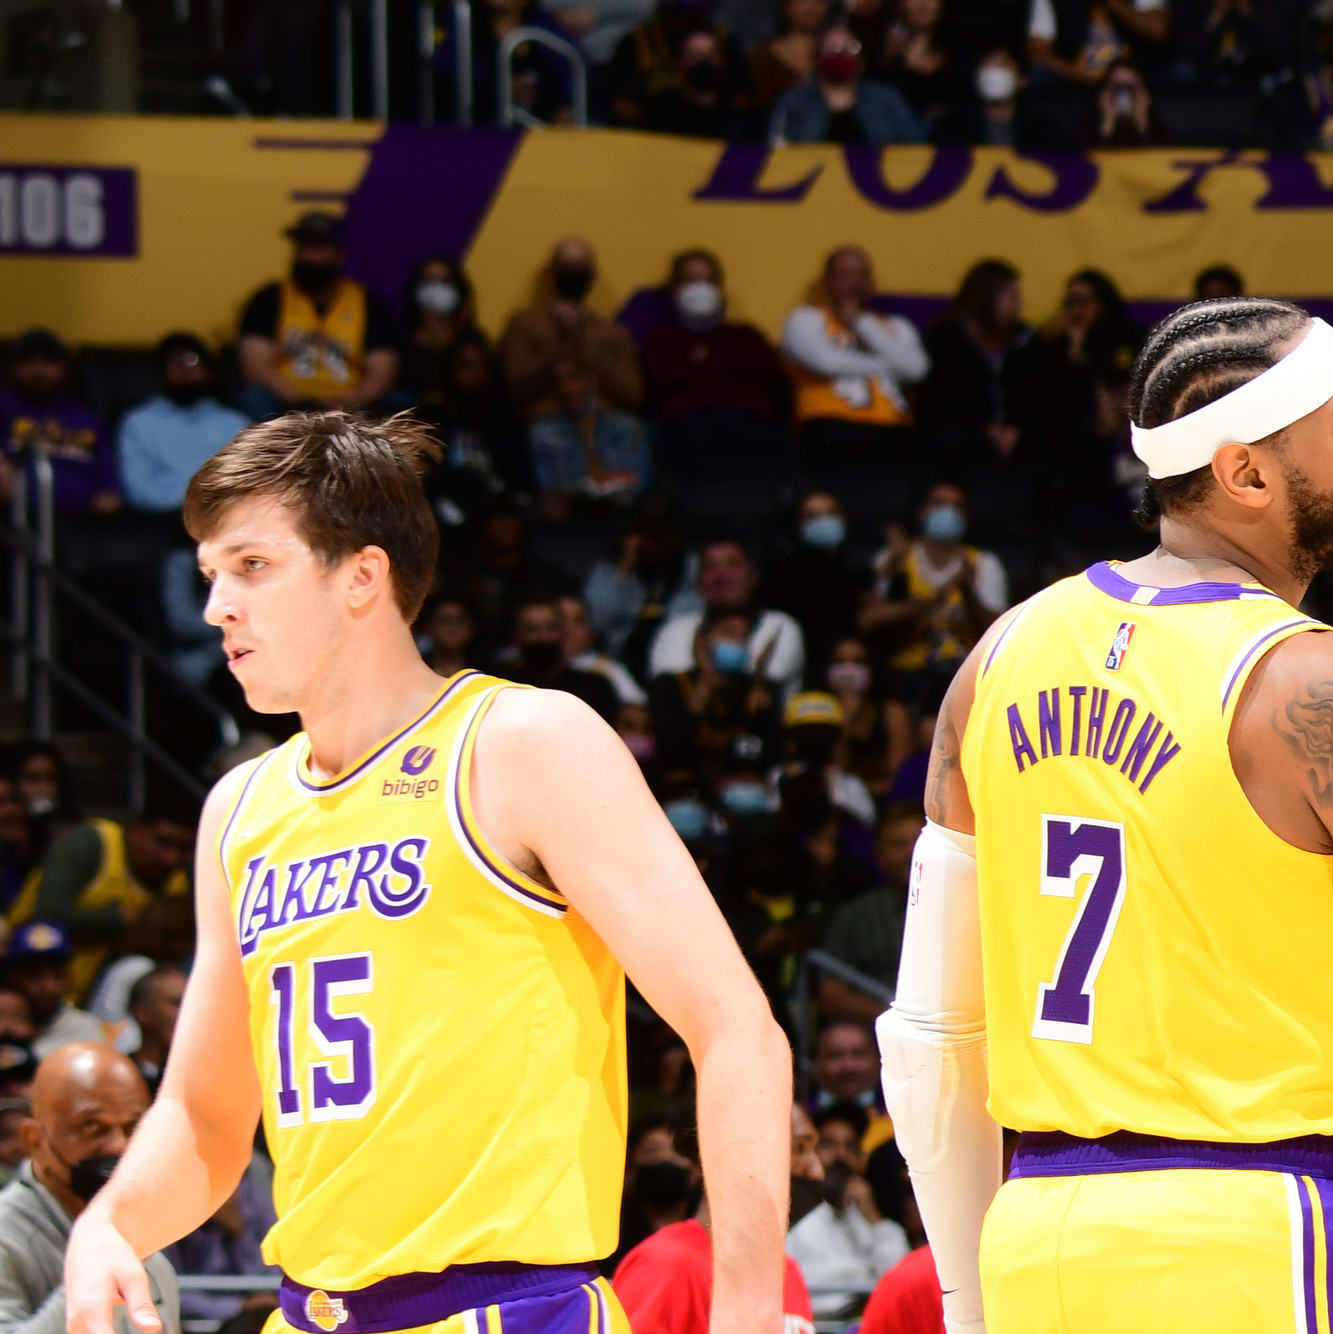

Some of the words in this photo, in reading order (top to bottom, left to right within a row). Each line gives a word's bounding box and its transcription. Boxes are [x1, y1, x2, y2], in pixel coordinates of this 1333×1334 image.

[0, 172, 107, 251] 106
[381, 779, 439, 799] bibigo
[1005, 685, 1182, 796] ANTHONY
[239, 834, 431, 959] LAKERS
[1031, 813, 1128, 1045] 7
[268, 950, 377, 1129] 15
